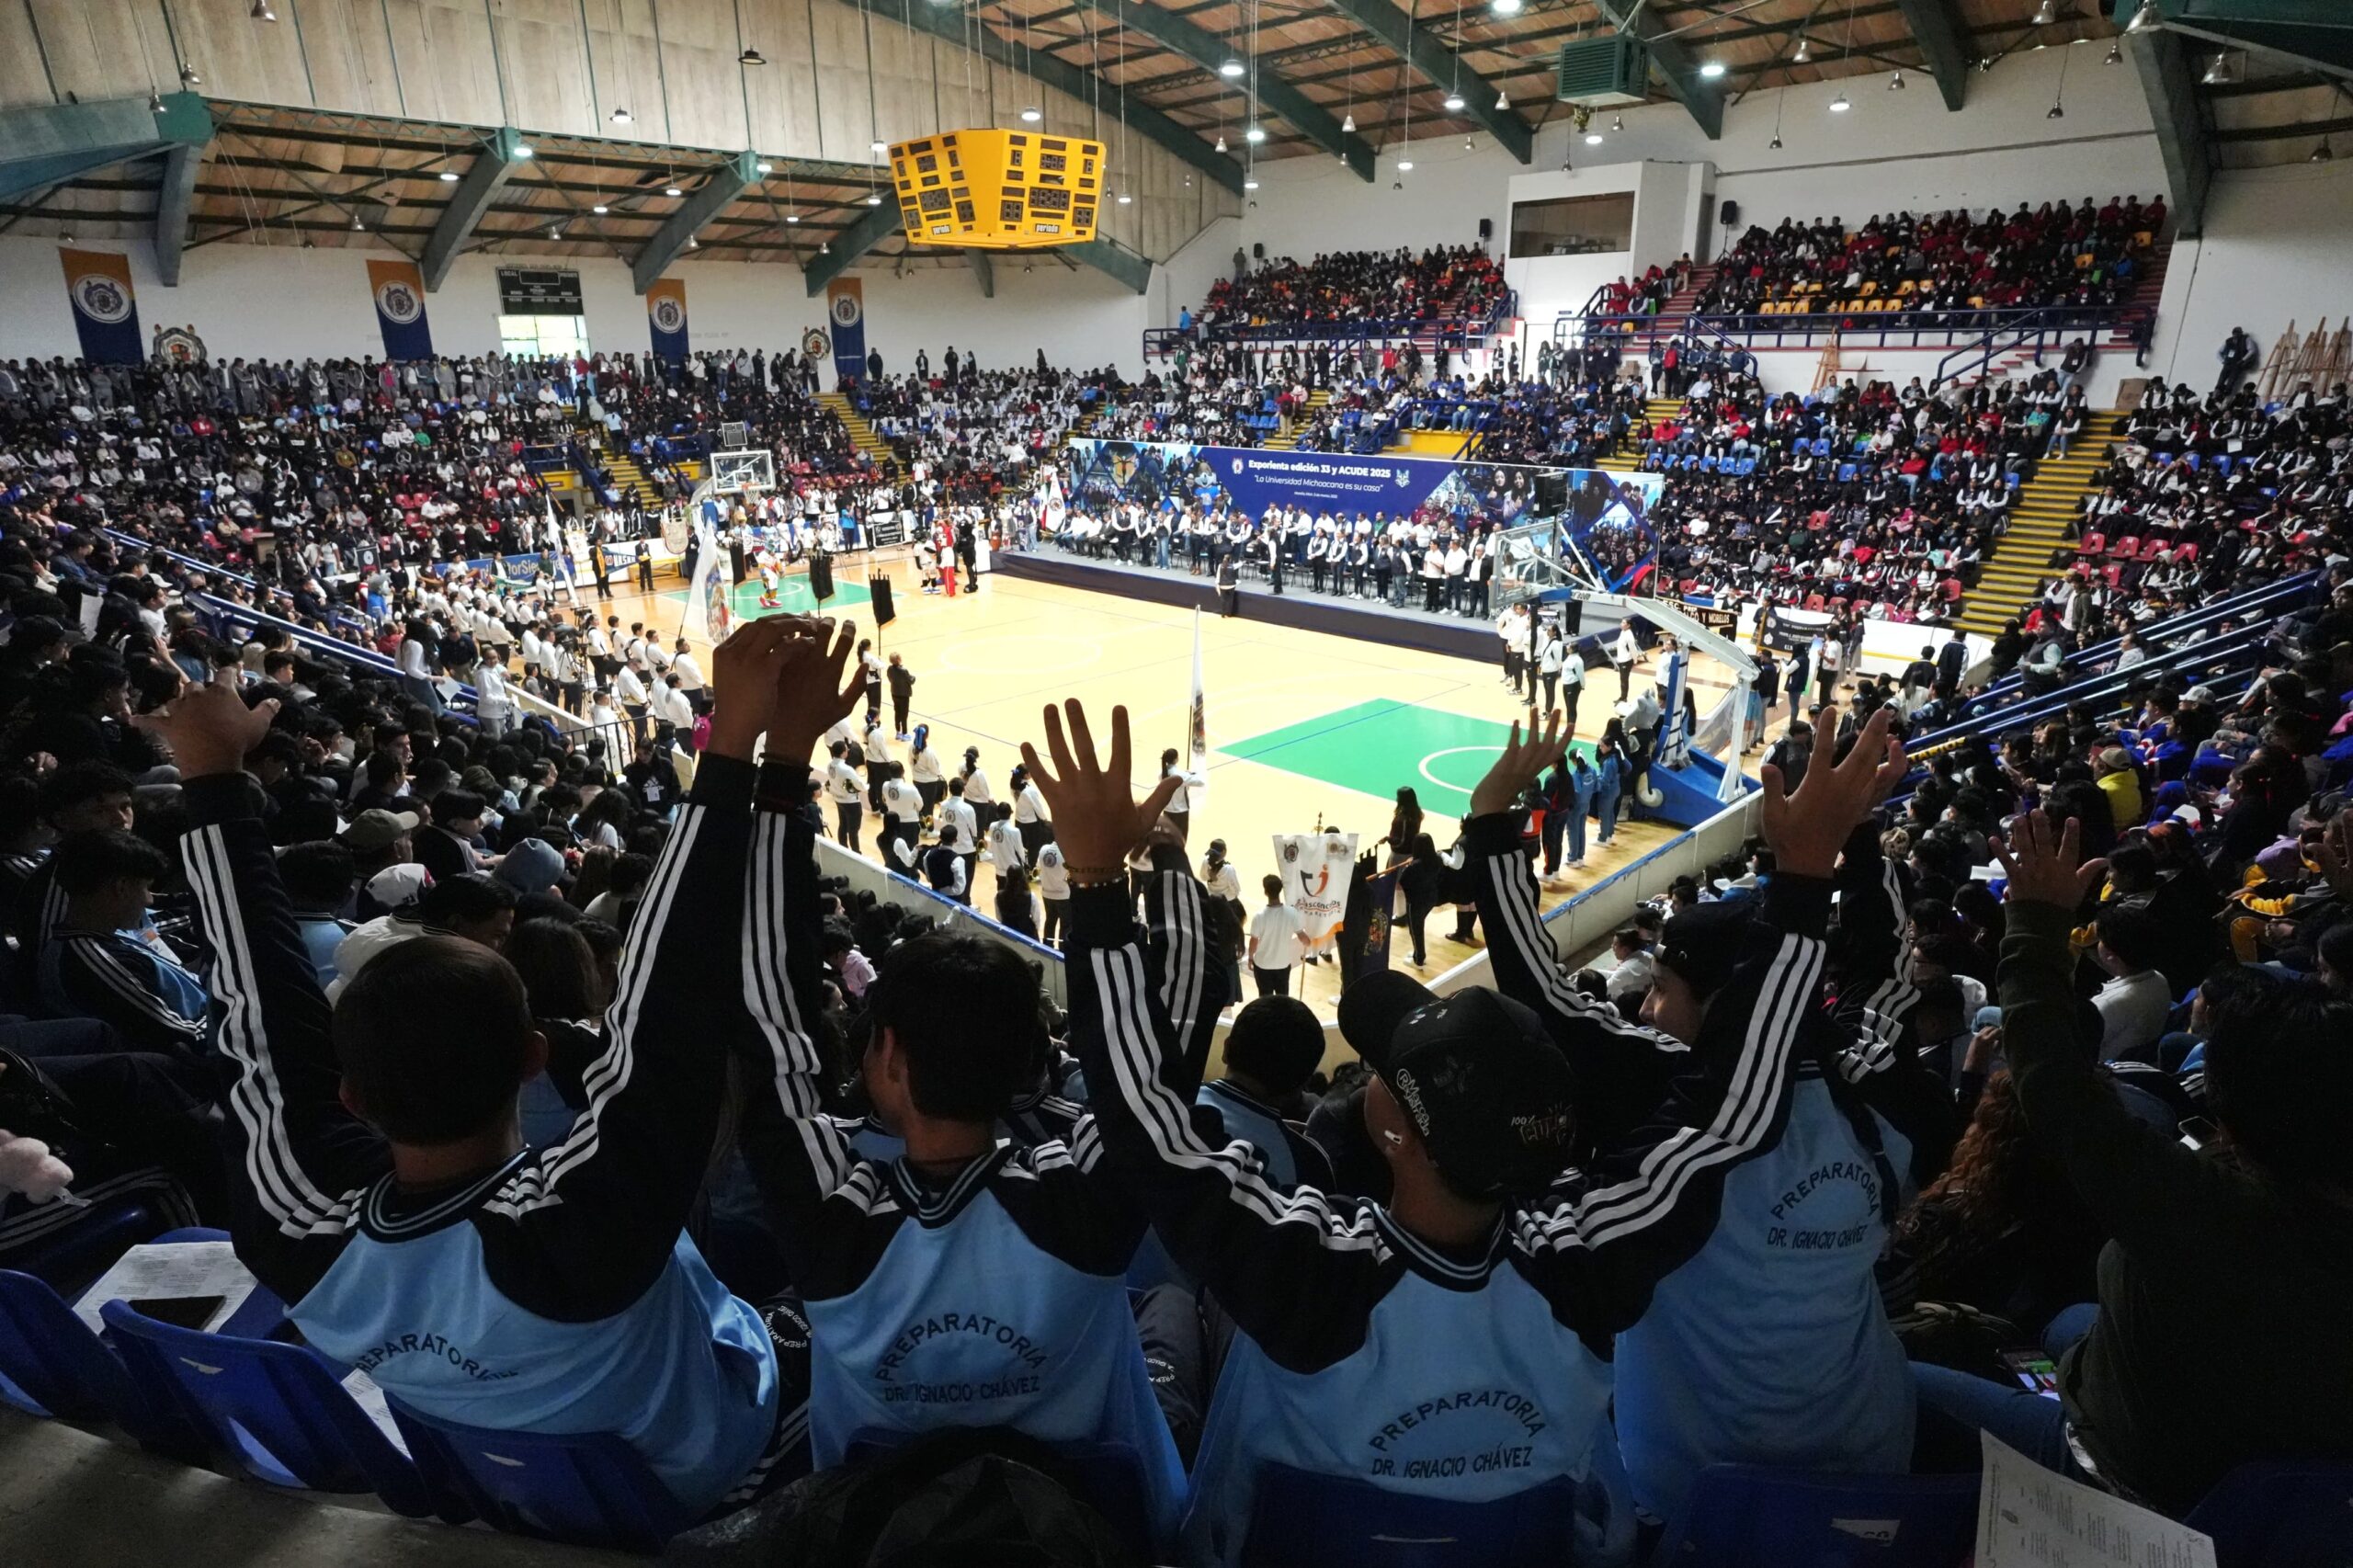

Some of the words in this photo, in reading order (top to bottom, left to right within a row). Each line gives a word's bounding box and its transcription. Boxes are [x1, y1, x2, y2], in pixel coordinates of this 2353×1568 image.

[1248, 460, 1289, 471] Exporienta
[1290, 462, 1319, 472] edición
[1321, 464, 1330, 473] 33
[1331, 466, 1337, 476] y
[1338, 466, 1369, 477] ACUDE
[1370, 468, 1392, 478] 2025
[1265, 476, 1302, 486] Universidad
[1302, 478, 1343, 489] Michoacana
[1701, 612, 1707, 624] Y
[1709, 613, 1730, 624] MORELOS
[1770, 1162, 1880, 1221] PREPARATORIA
[1768, 1227, 1787, 1248] DR.
[1792, 1230, 1836, 1250] IGNACIO
[355, 1333, 494, 1381] REPARATORI
[875, 1313, 1047, 1381] PREPARATORIA
[885, 1386, 908, 1403] DR.
[915, 1382, 972, 1403] IGNACIO
[980, 1374, 1041, 1400] CHÁVEZ
[1369, 1391, 1546, 1452] PREPARATORIA
[1372, 1459, 1395, 1476] DR.
[1404, 1456, 1466, 1479] IGNACIO
[1473, 1442, 1533, 1472] CHÁVEZ
